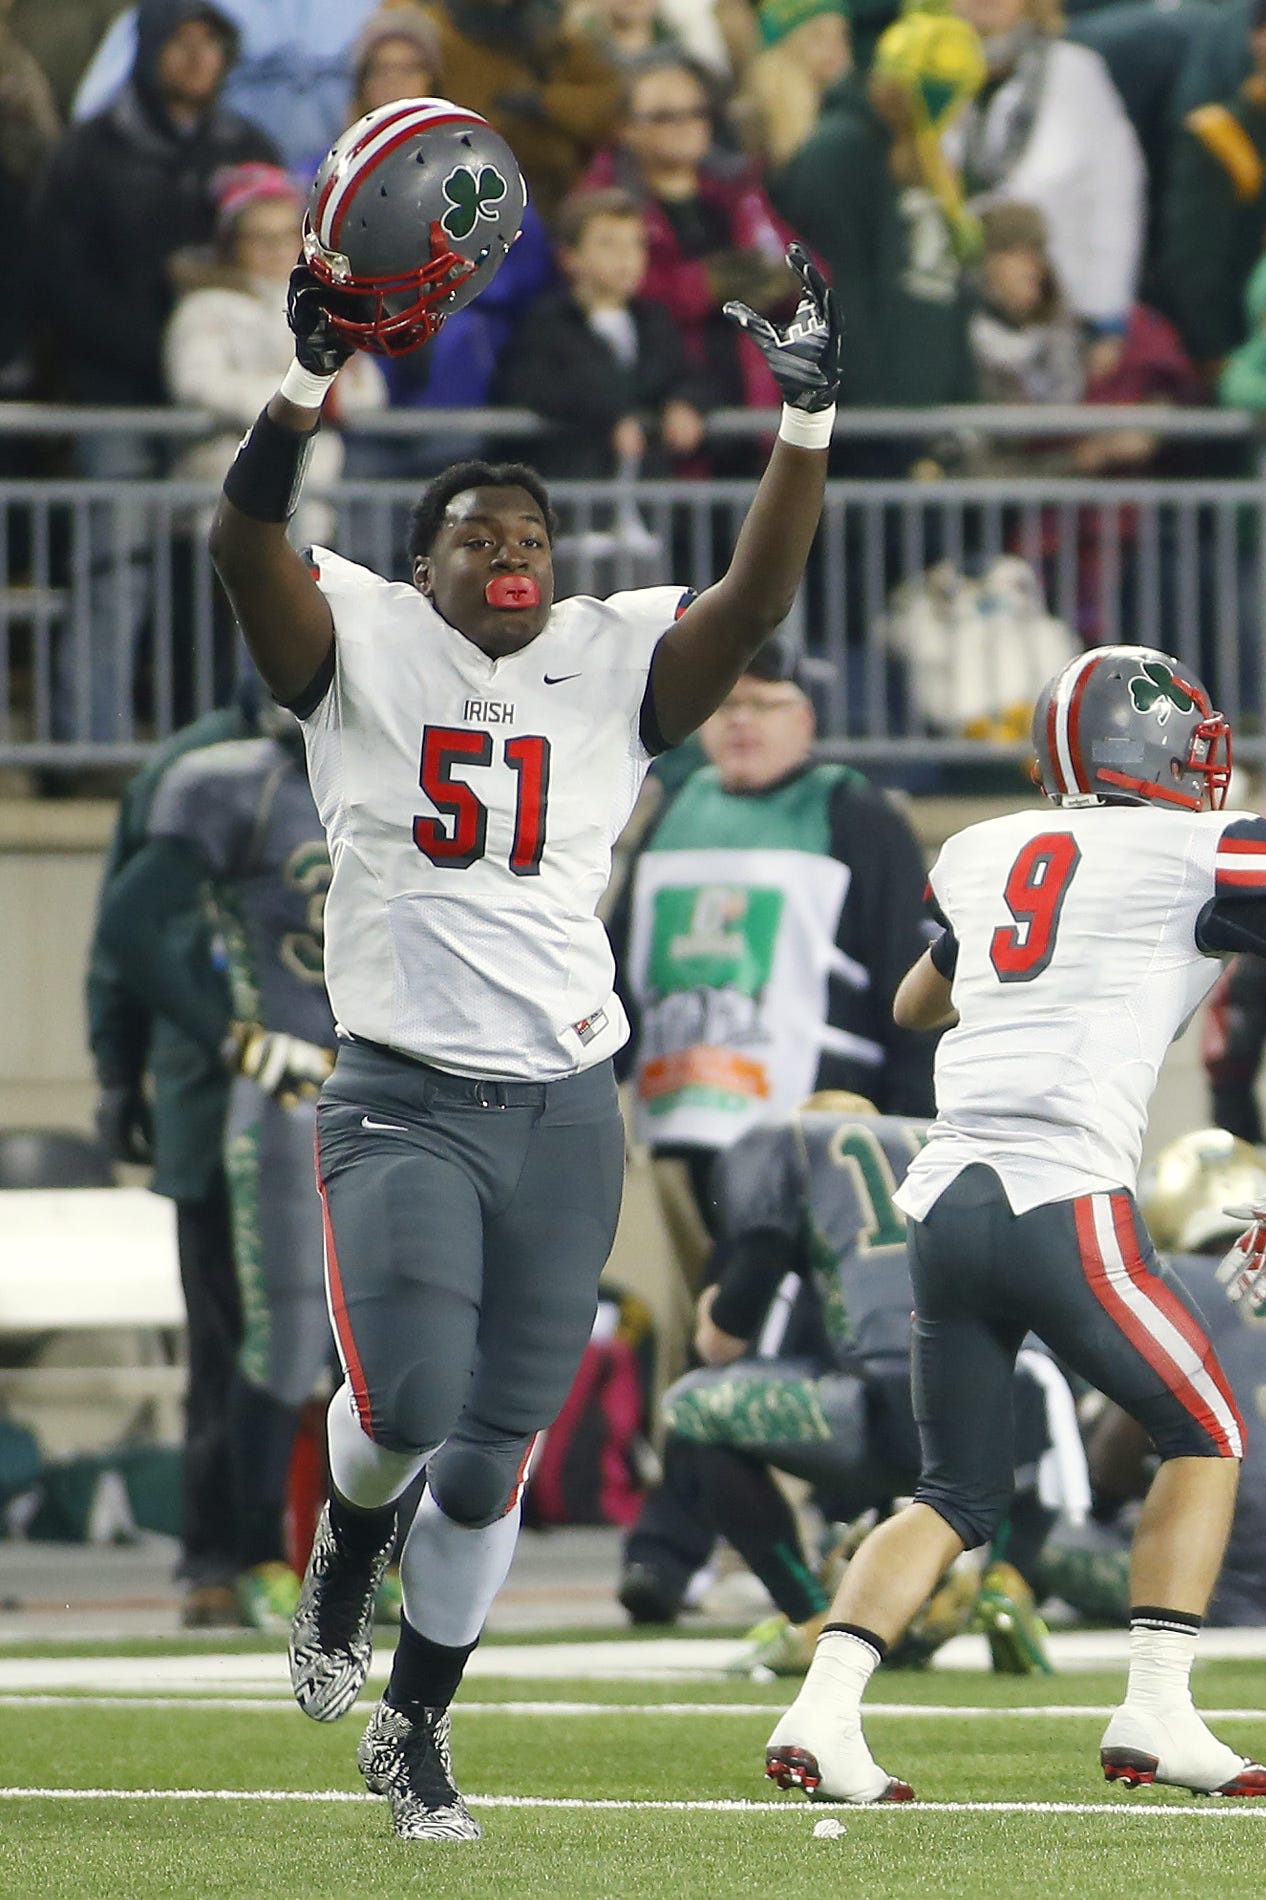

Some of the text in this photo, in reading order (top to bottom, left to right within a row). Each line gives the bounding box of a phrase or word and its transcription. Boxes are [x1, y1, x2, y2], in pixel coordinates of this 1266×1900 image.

[464, 699, 515, 725] IRISH
[412, 724, 552, 877] 51
[989, 831, 1083, 983] 9
